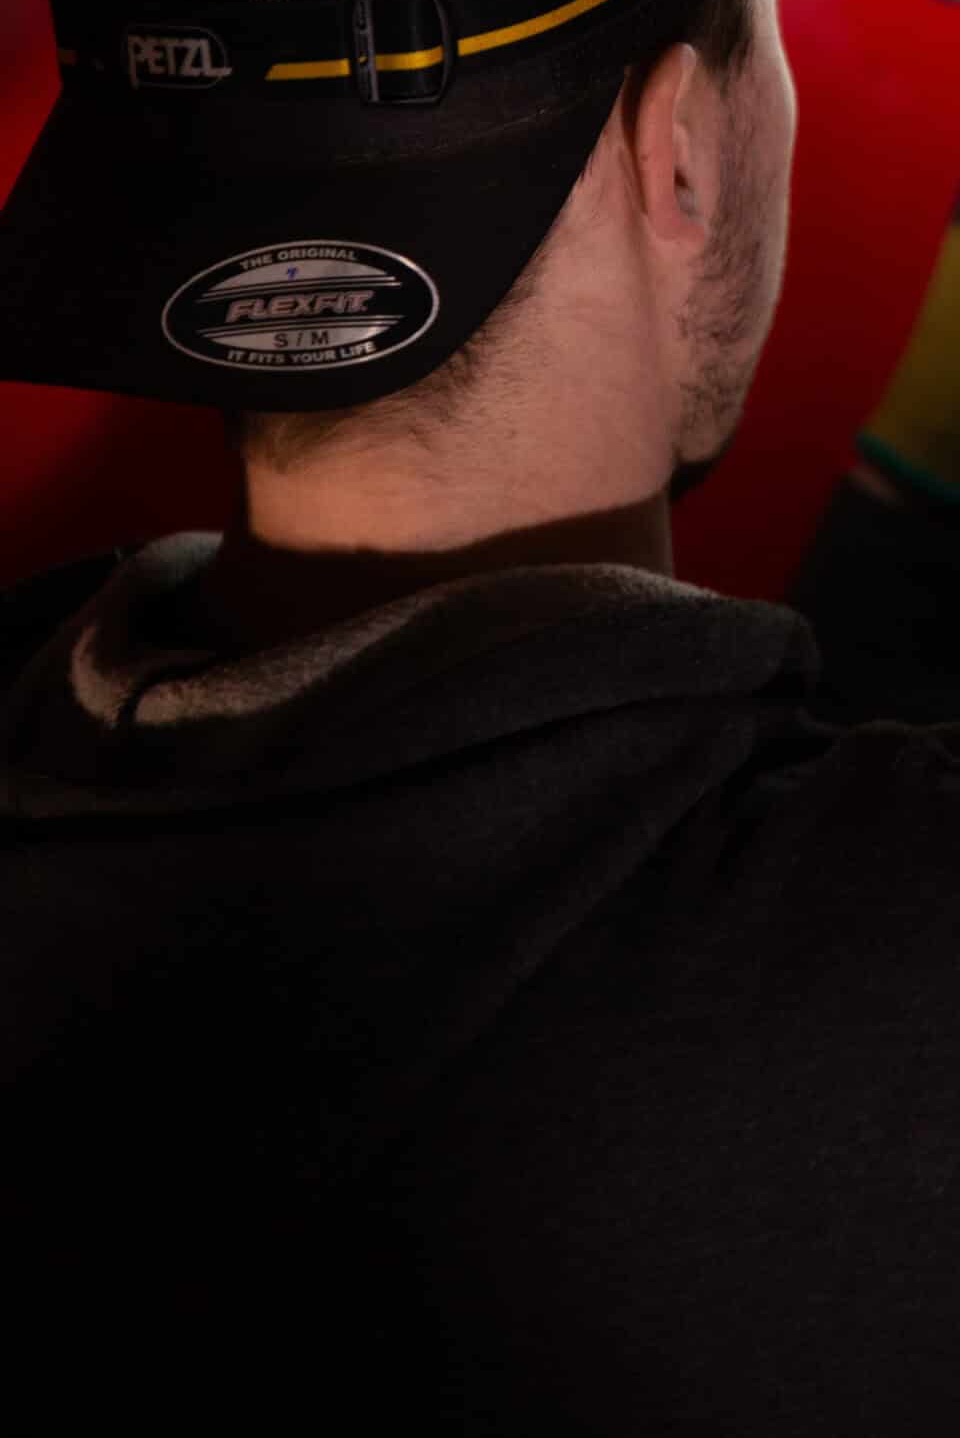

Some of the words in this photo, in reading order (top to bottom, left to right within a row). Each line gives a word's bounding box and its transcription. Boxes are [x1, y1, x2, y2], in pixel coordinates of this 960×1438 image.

[127, 34, 233, 90] PETZL
[239, 256, 273, 271] THE
[277, 247, 358, 261] ORIGINAL
[225, 290, 375, 323] FLEXFIT
[227, 349, 244, 362] IT
[250, 351, 286, 364] FITS
[291, 349, 337, 364] YOUR
[340, 340, 377, 358] LIFE
